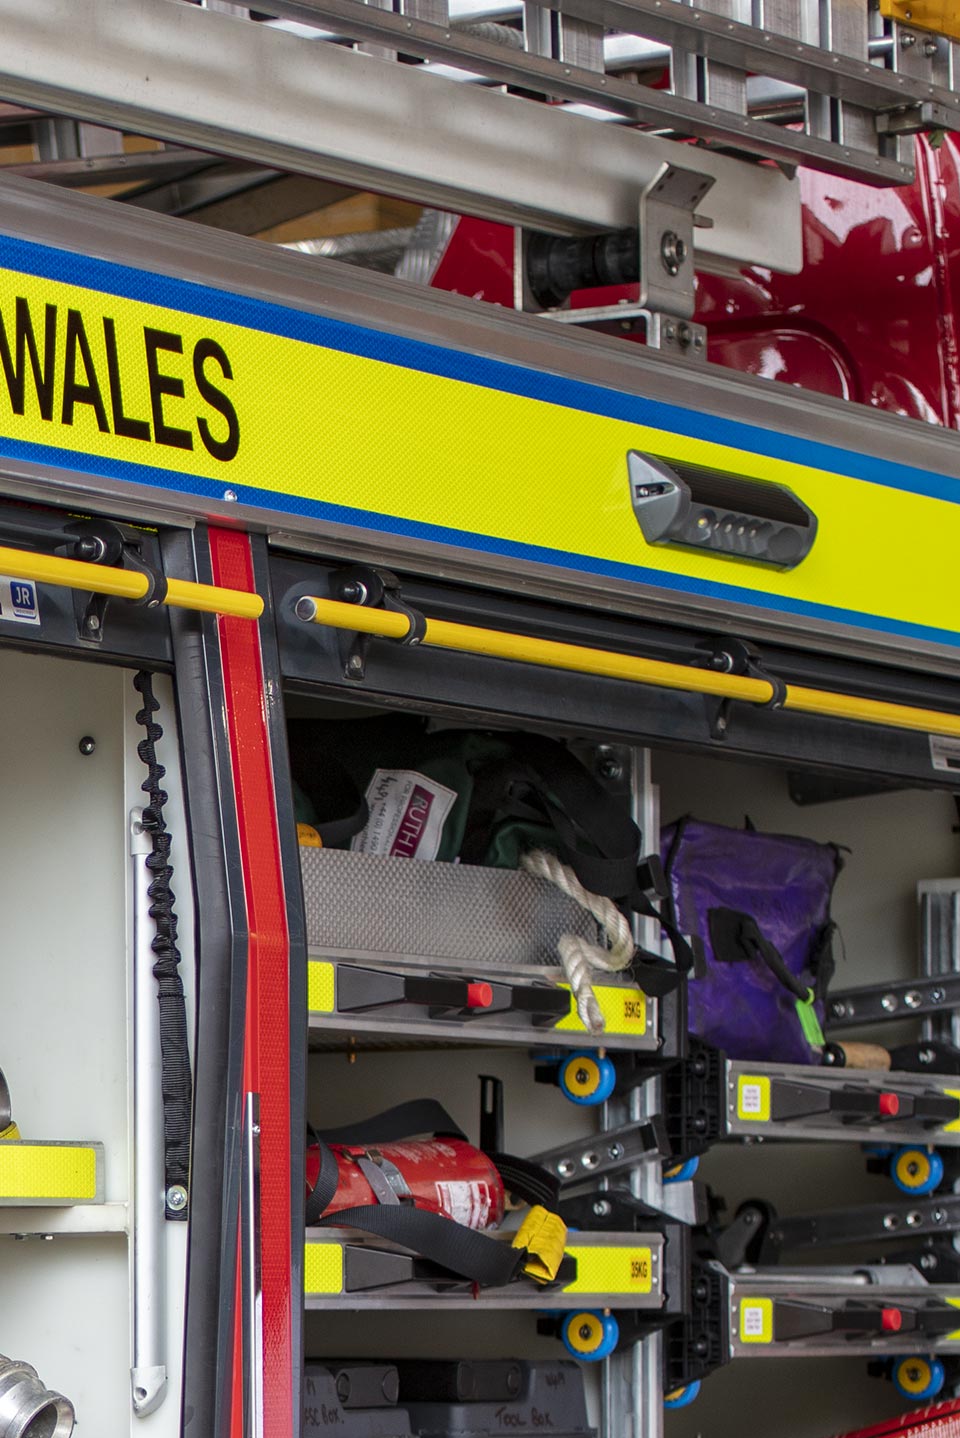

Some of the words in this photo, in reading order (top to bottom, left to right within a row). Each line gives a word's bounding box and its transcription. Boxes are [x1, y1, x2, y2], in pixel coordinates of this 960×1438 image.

[0, 296, 240, 462] WALES
[15, 586, 31, 605] JR
[398, 795, 428, 848] RUTH
[625, 1001, 641, 1018] 35KG
[631, 1261, 648, 1278] 35KG
